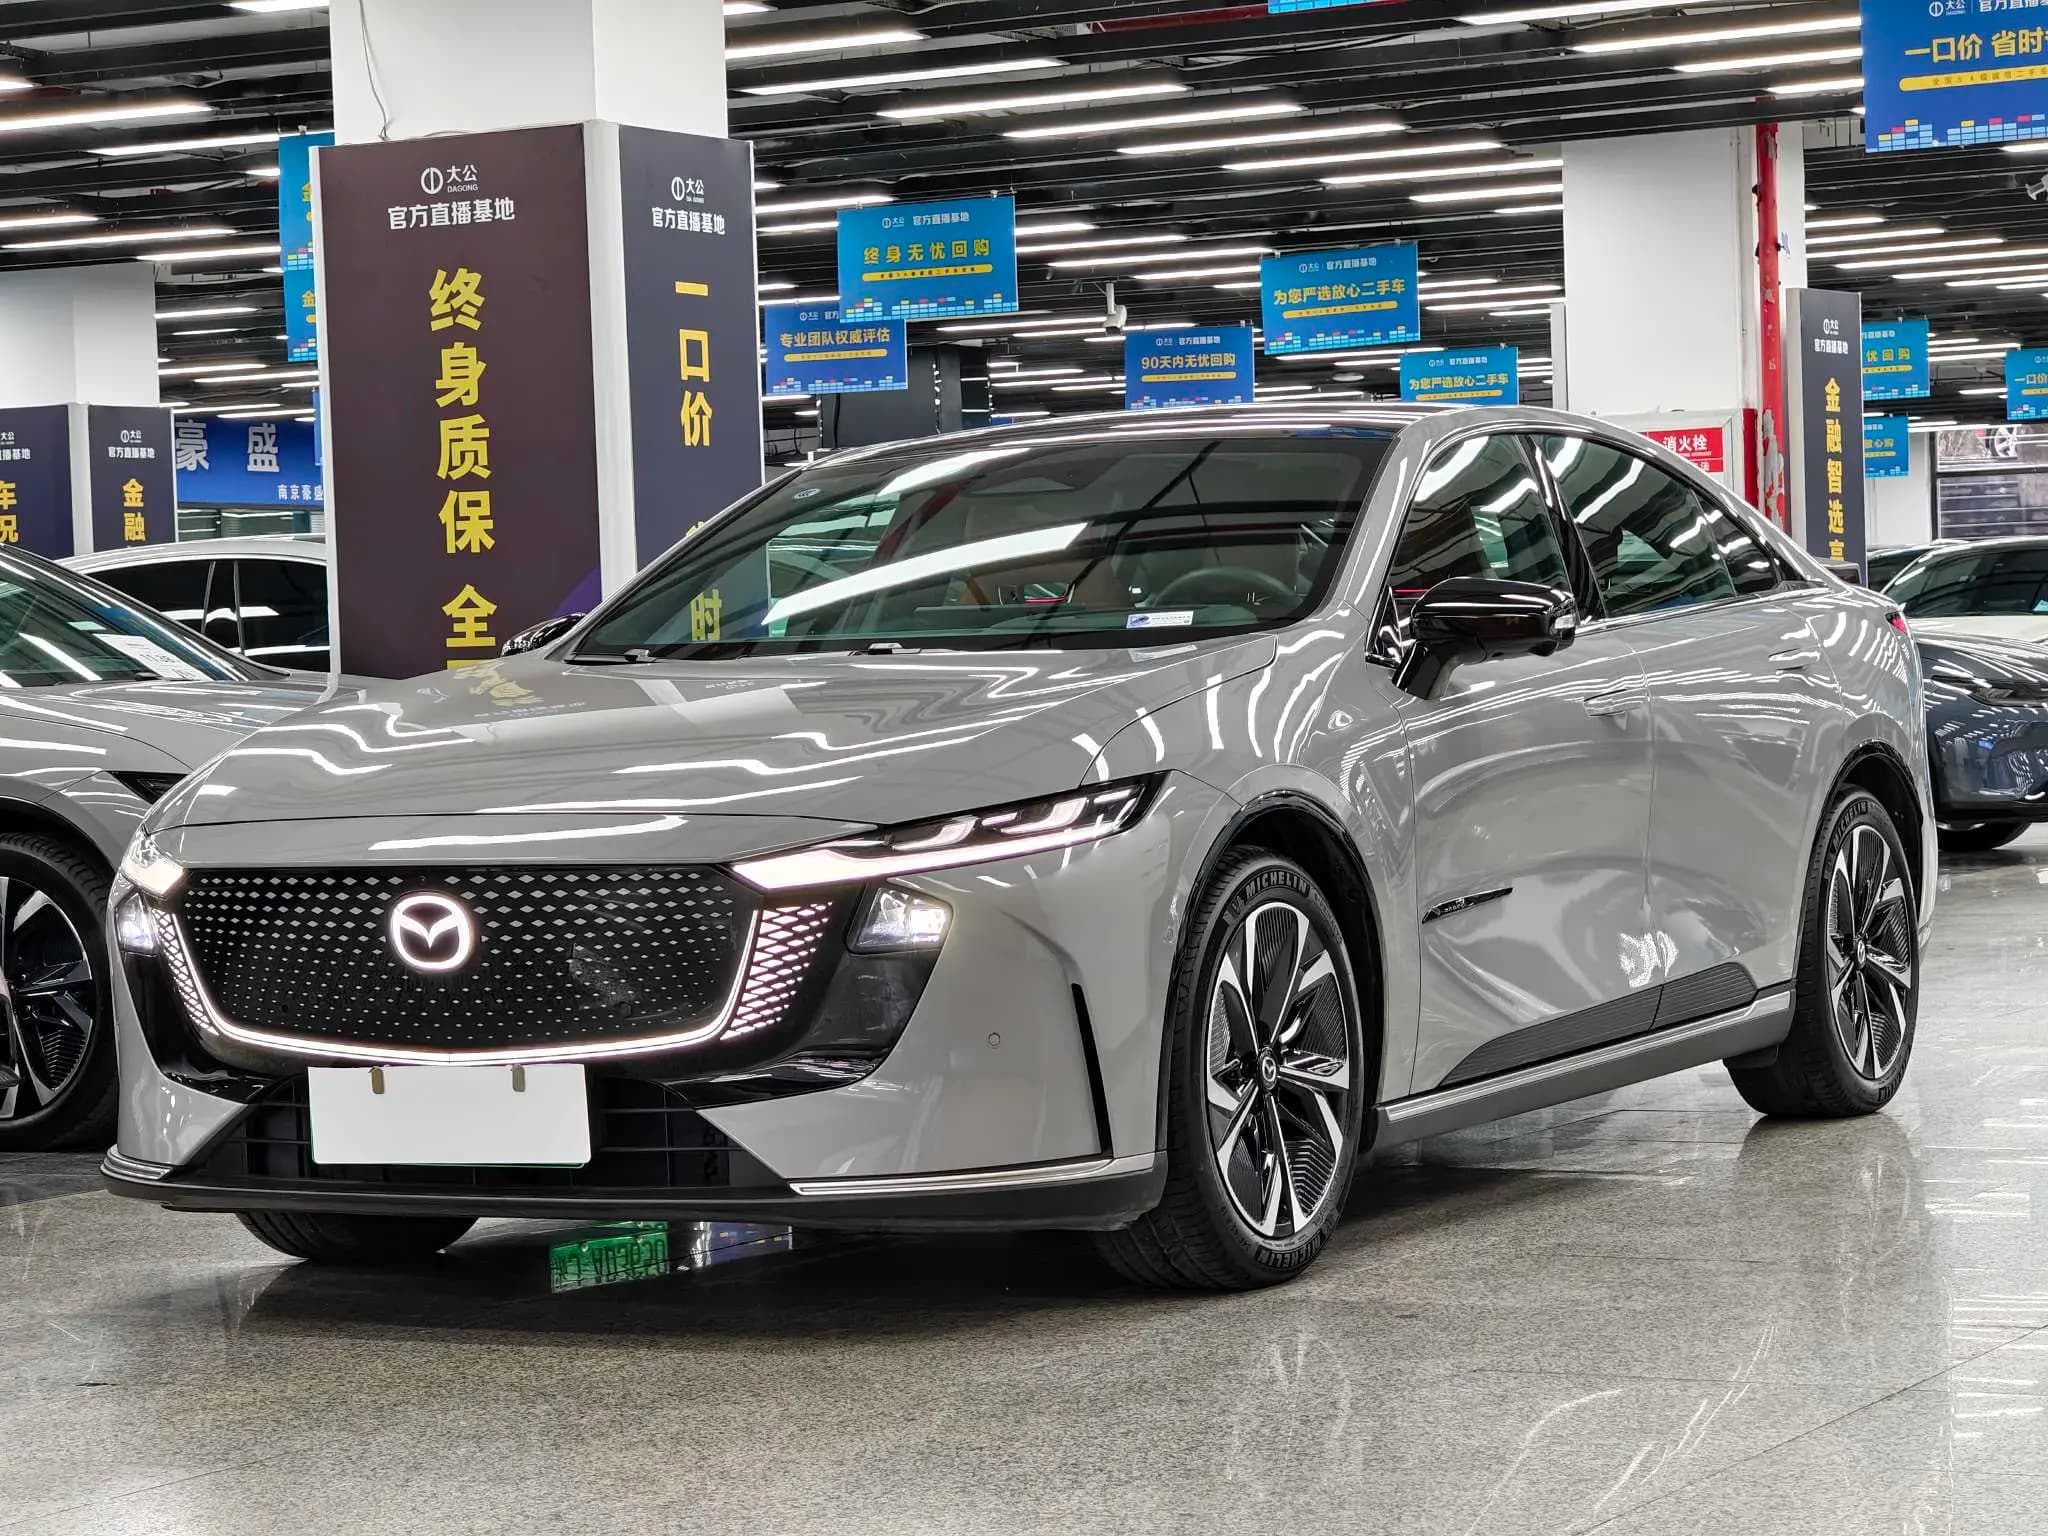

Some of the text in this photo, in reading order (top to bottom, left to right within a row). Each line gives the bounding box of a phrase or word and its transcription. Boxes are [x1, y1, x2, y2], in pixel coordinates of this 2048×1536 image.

[1904, 26, 2048, 62] 一口价 省时
[447, 164, 478, 183] 大公
[447, 184, 478, 193] DAGONG
[685, 177, 705, 196] 大公
[387, 197, 516, 230] 官方直播基地
[651, 206, 726, 235] 官方直播基地
[912, 211, 970, 226] 官方直播基地
[863, 239, 990, 265] 终身无忧回购
[1273, 278, 1406, 306] 为您严选放心二手车
[779, 327, 891, 348] 专业团队权威评估
[674, 281, 713, 447] 一口价
[1141, 353, 1236, 369] 90天内无忧回购
[107, 446, 156, 459] 官方直播基地
[1663, 433, 1709, 452] 消火栓
[0, 448, 31, 461] 播基地
[428, 267, 498, 671] 终身质保 全
[122, 478, 146, 541] 金融
[1245, 870, 1308, 897] MICHELIN
